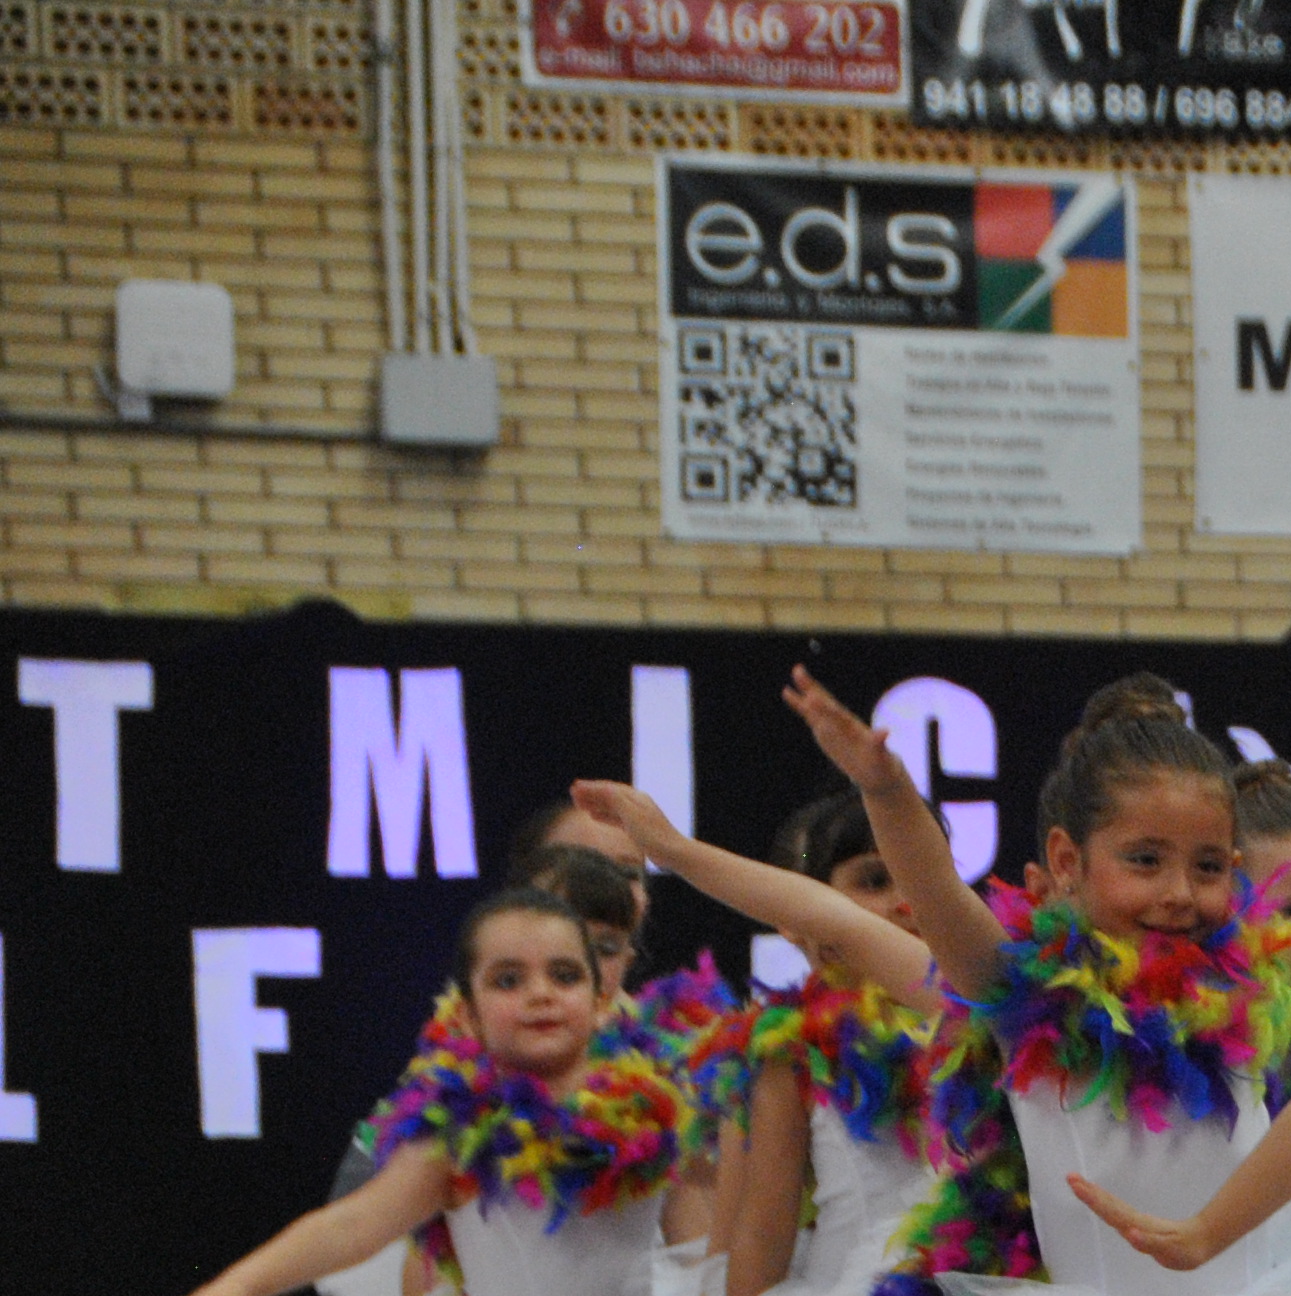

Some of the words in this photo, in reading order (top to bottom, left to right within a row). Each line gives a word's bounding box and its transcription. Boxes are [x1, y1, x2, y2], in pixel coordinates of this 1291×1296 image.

[604, 0, 690, 46] 630
[706, 2, 791, 51] 466
[804, 5, 886, 56] 202
[923, 77, 986, 119] 941
[1001, 79, 1043, 120] 18
[1103, 82, 1146, 124] 88
[1174, 85, 1238, 128] 696
[685, 185, 963, 296] e.d.s
